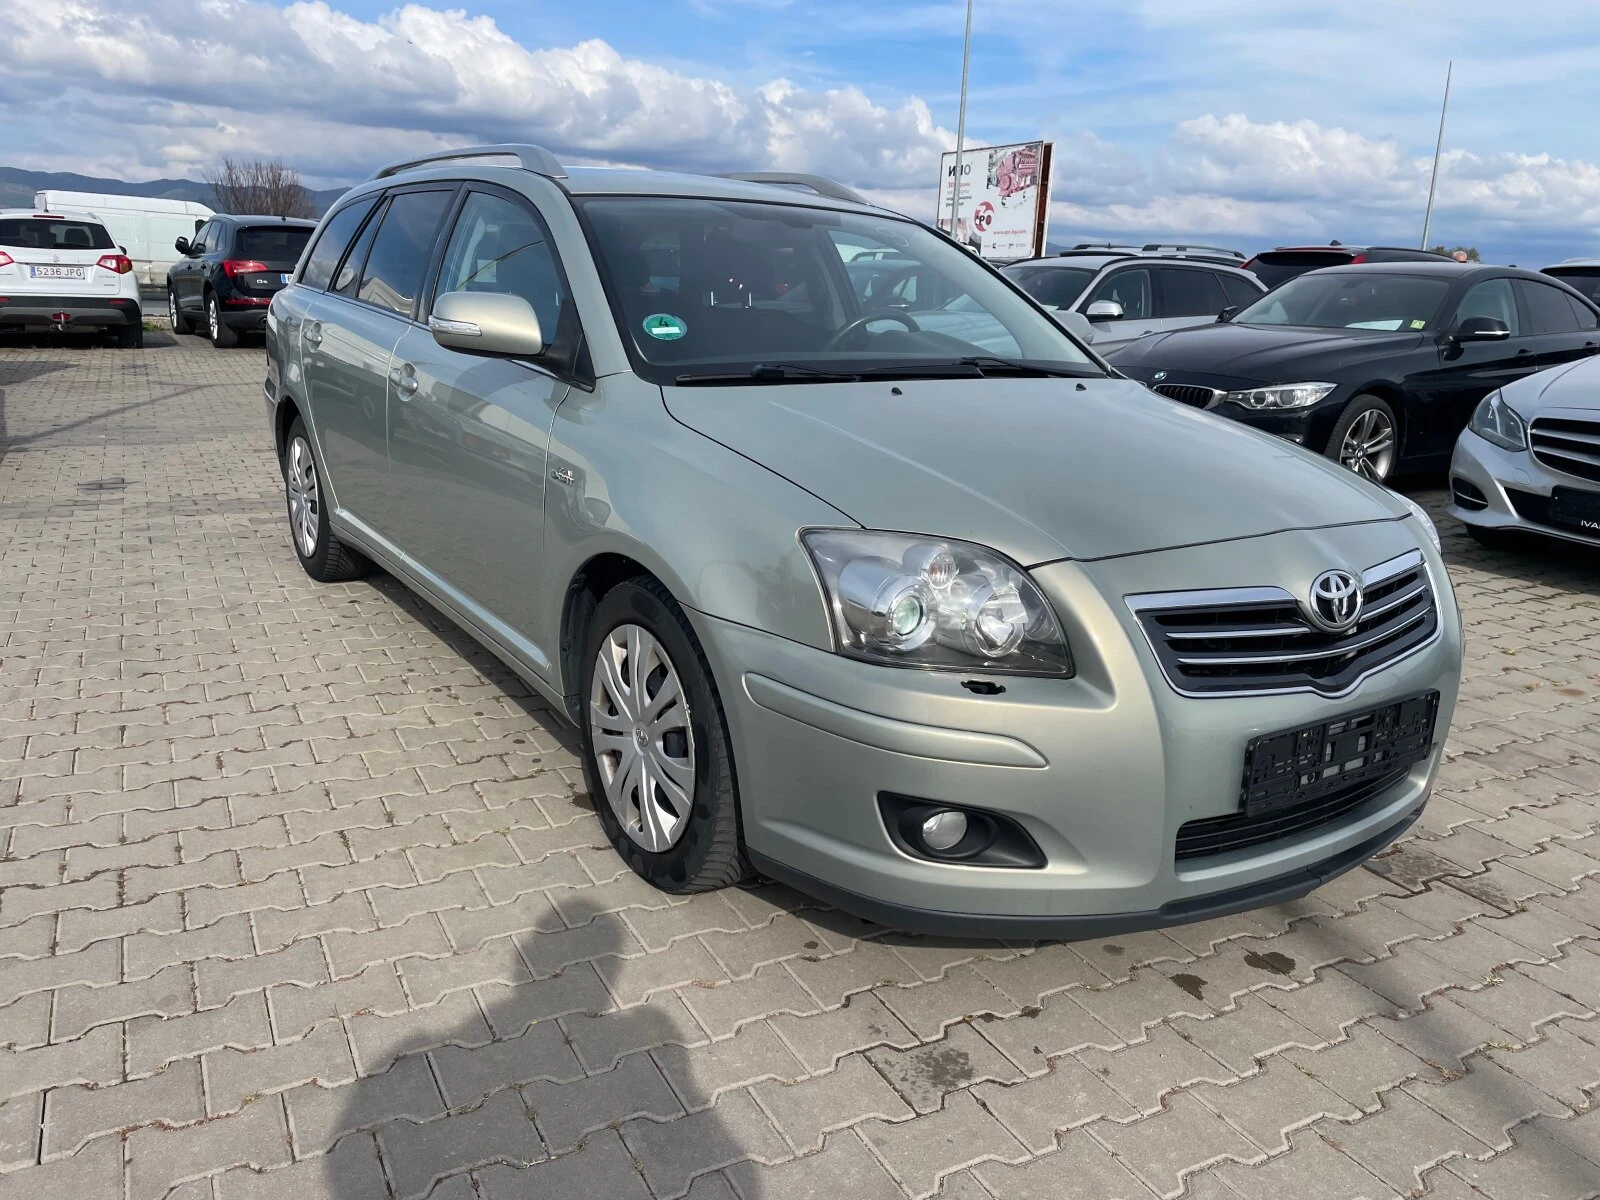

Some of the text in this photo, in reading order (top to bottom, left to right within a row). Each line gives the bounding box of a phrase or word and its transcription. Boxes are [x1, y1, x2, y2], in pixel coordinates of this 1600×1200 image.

[36, 267, 82, 277] 5236 JPG
[659, 317, 669, 327] 4
[1581, 520, 1600, 529] IVA
